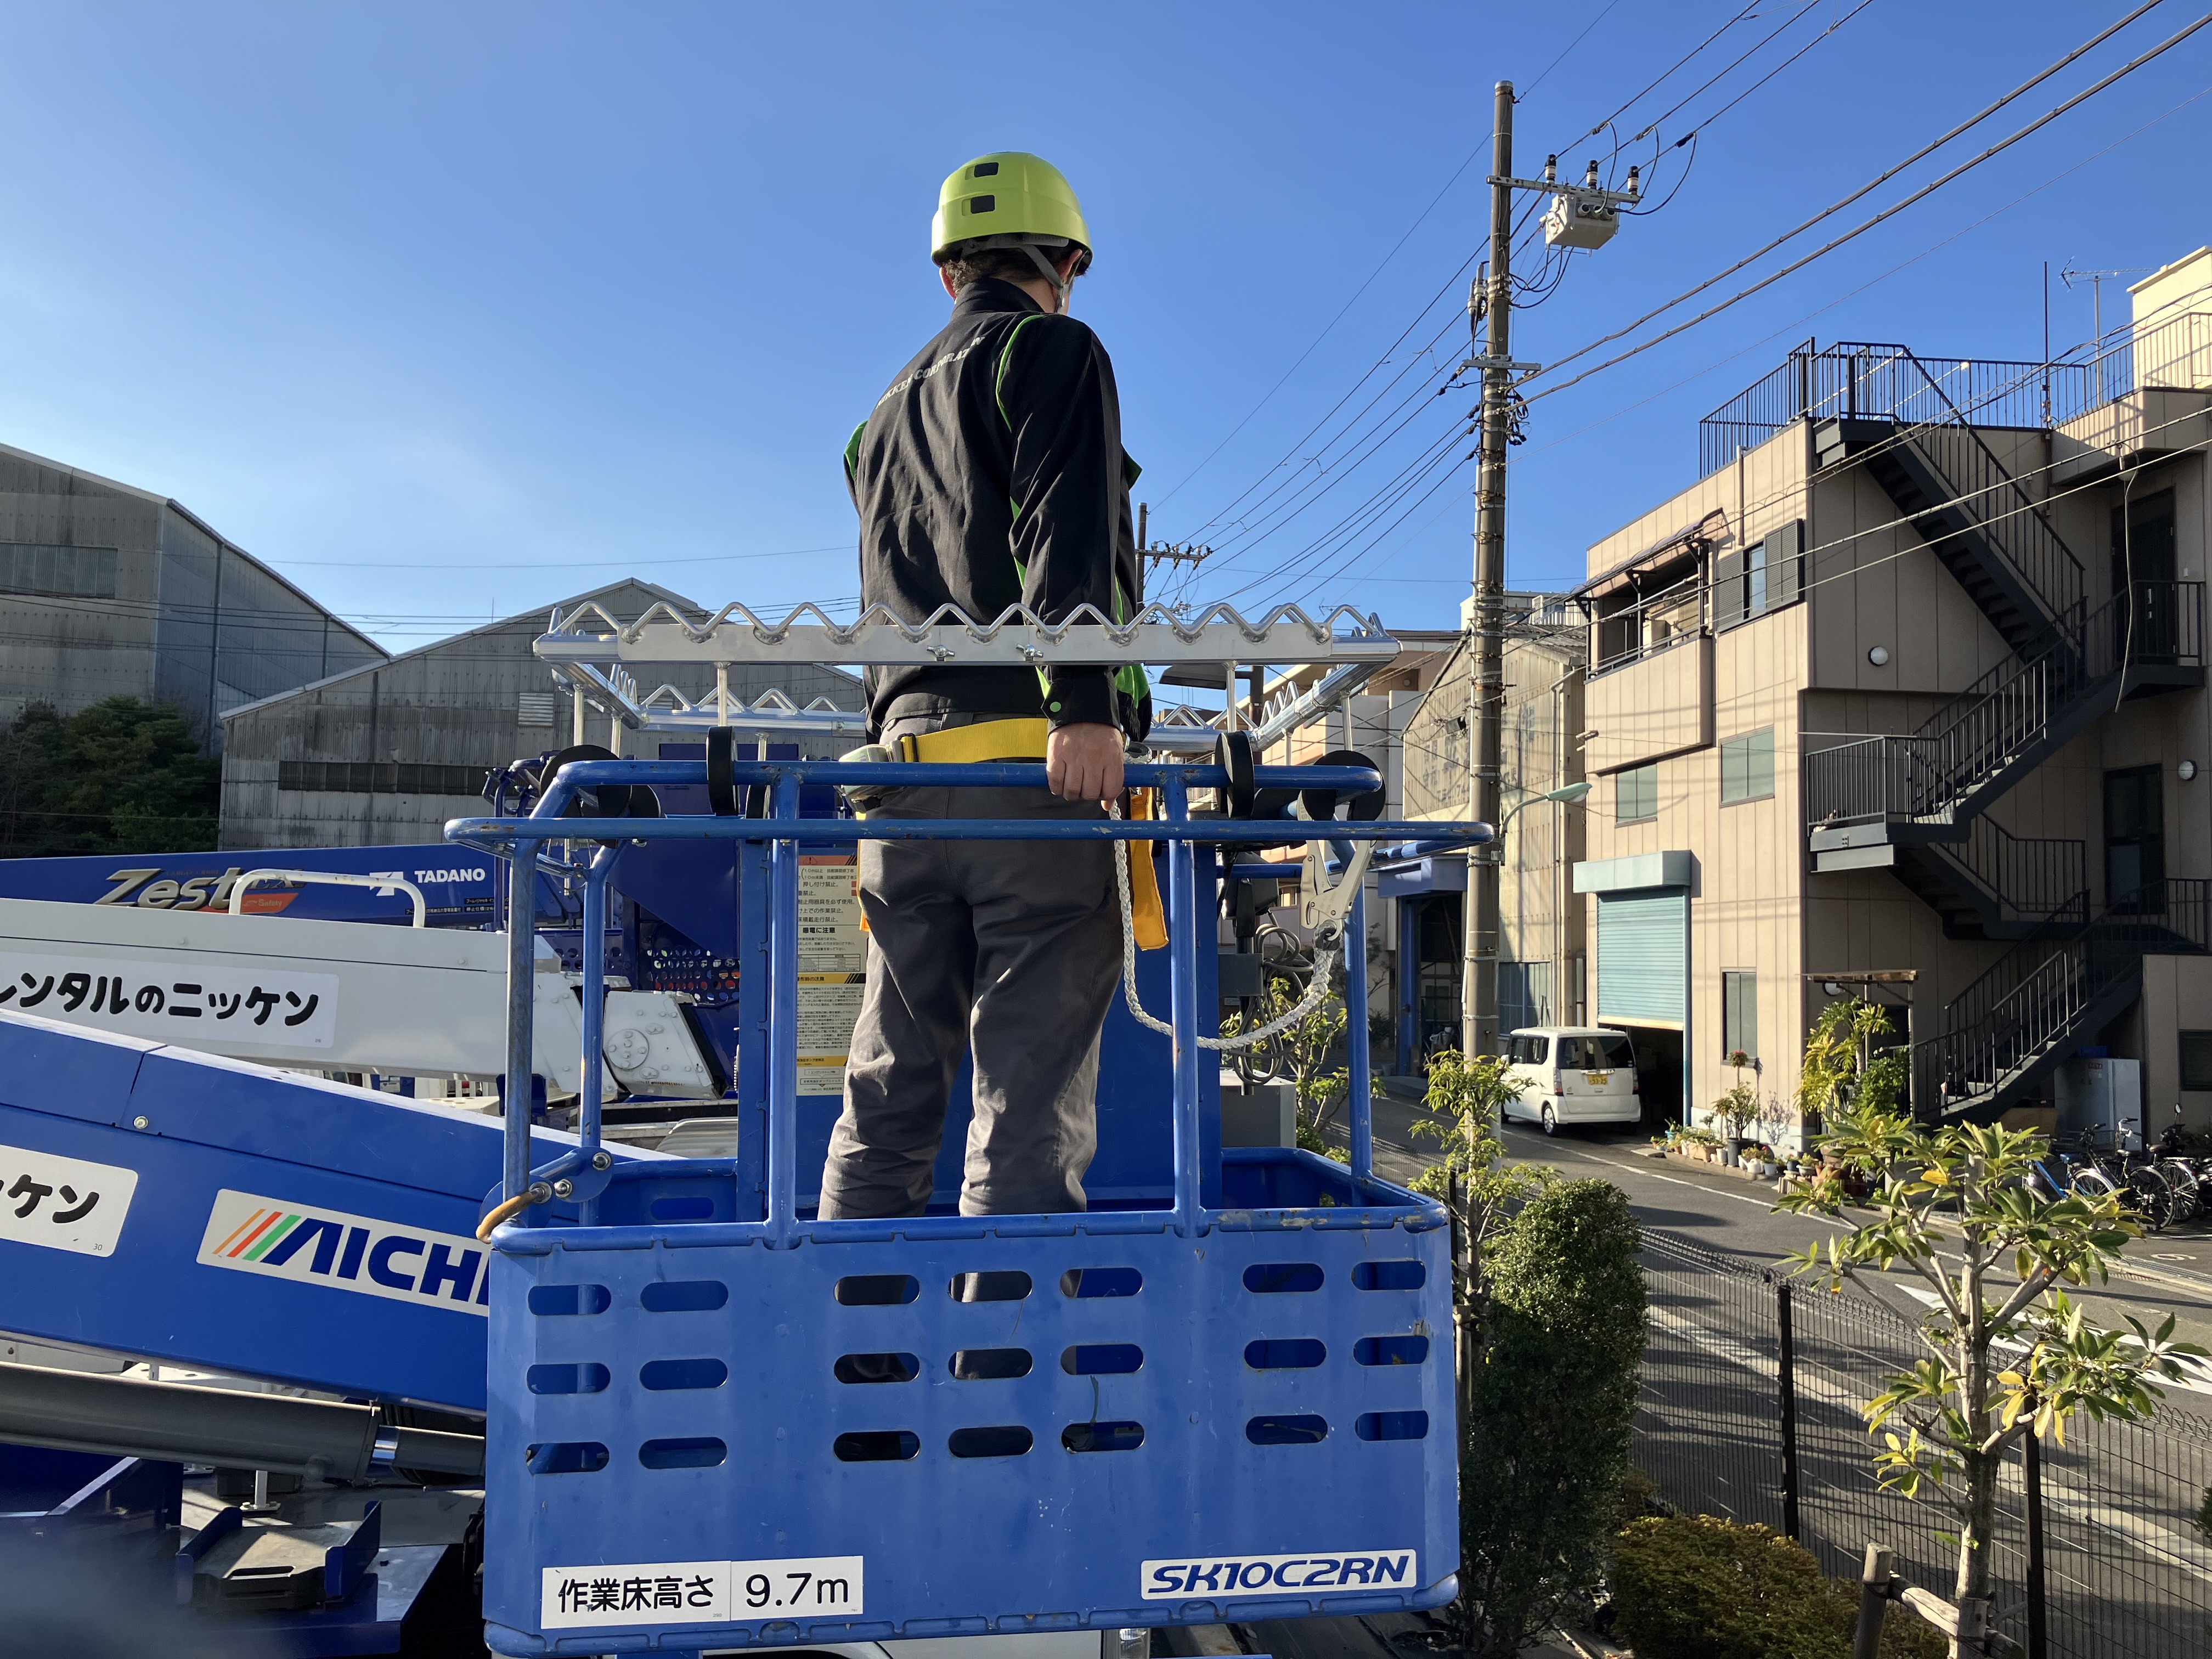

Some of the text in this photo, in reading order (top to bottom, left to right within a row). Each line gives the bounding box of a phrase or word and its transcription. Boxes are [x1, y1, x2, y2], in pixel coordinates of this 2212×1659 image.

[876, 337, 985, 409] NIKKEN CORPORATN
[93, 867, 239, 910] Zest
[414, 868, 486, 883] TADANO
[258, 899, 282, 907] Safety
[0, 1174, 100, 1224] ケン
[558, 1572, 849, 1613] 作業床高さ 9.7m
[1148, 1555, 1409, 1594] SK10C2RN
